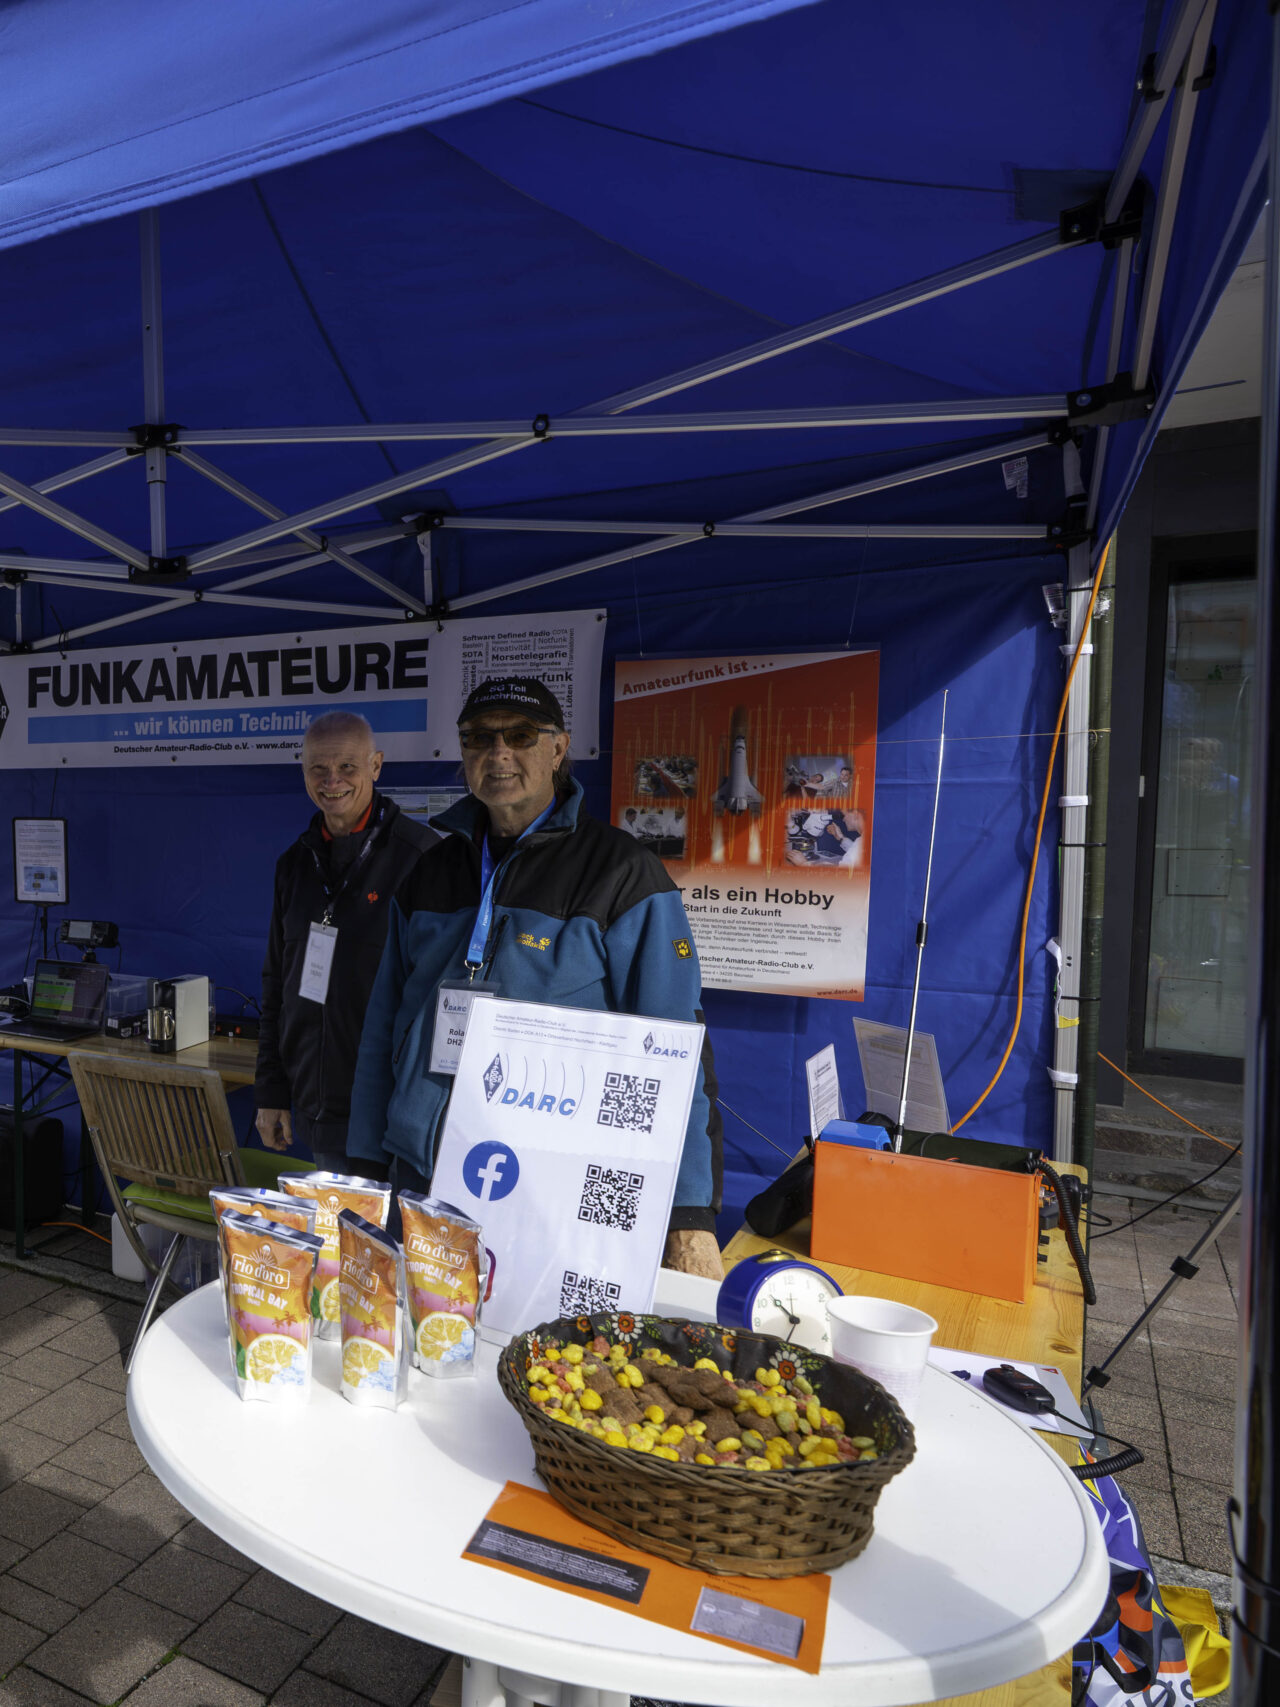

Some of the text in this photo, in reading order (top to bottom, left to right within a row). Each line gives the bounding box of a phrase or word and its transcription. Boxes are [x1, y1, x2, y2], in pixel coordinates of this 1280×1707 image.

[462, 634, 495, 642] Software
[492, 651, 567, 662] Morsetelegrafie
[27, 639, 429, 708] FUNKAMATEURE
[622, 664, 724, 695] Amateurfunk
[728, 661, 748, 675] ist
[134, 717, 163, 736] wir
[169, 714, 234, 735] können
[239, 711, 312, 733] Technik
[113, 740, 303, 754] Deutscher Amateur-Radio-Club e.V. www.darc.
[692, 885, 720, 901] als
[727, 887, 756, 903] ein
[764, 888, 835, 910] Hobby
[683, 903, 782, 918] Start in die Zukunft
[699, 955, 724, 964] utscher
[725, 957, 799, 970] Amateur-Radio-Club
[801, 963, 815, 971] e.V.
[448, 1005, 468, 1013] DARC
[447, 1037, 463, 1047] DH2
[449, 1028, 465, 1037] Rola
[653, 1045, 689, 1060] DARC
[501, 1087, 577, 1116] DARC
[411, 1238, 463, 1265] rio d'oro
[234, 1258, 284, 1285] rio d'oro
[406, 1261, 463, 1290] TROPICAL BAY
[231, 1282, 288, 1311] TROPICAL BAY
